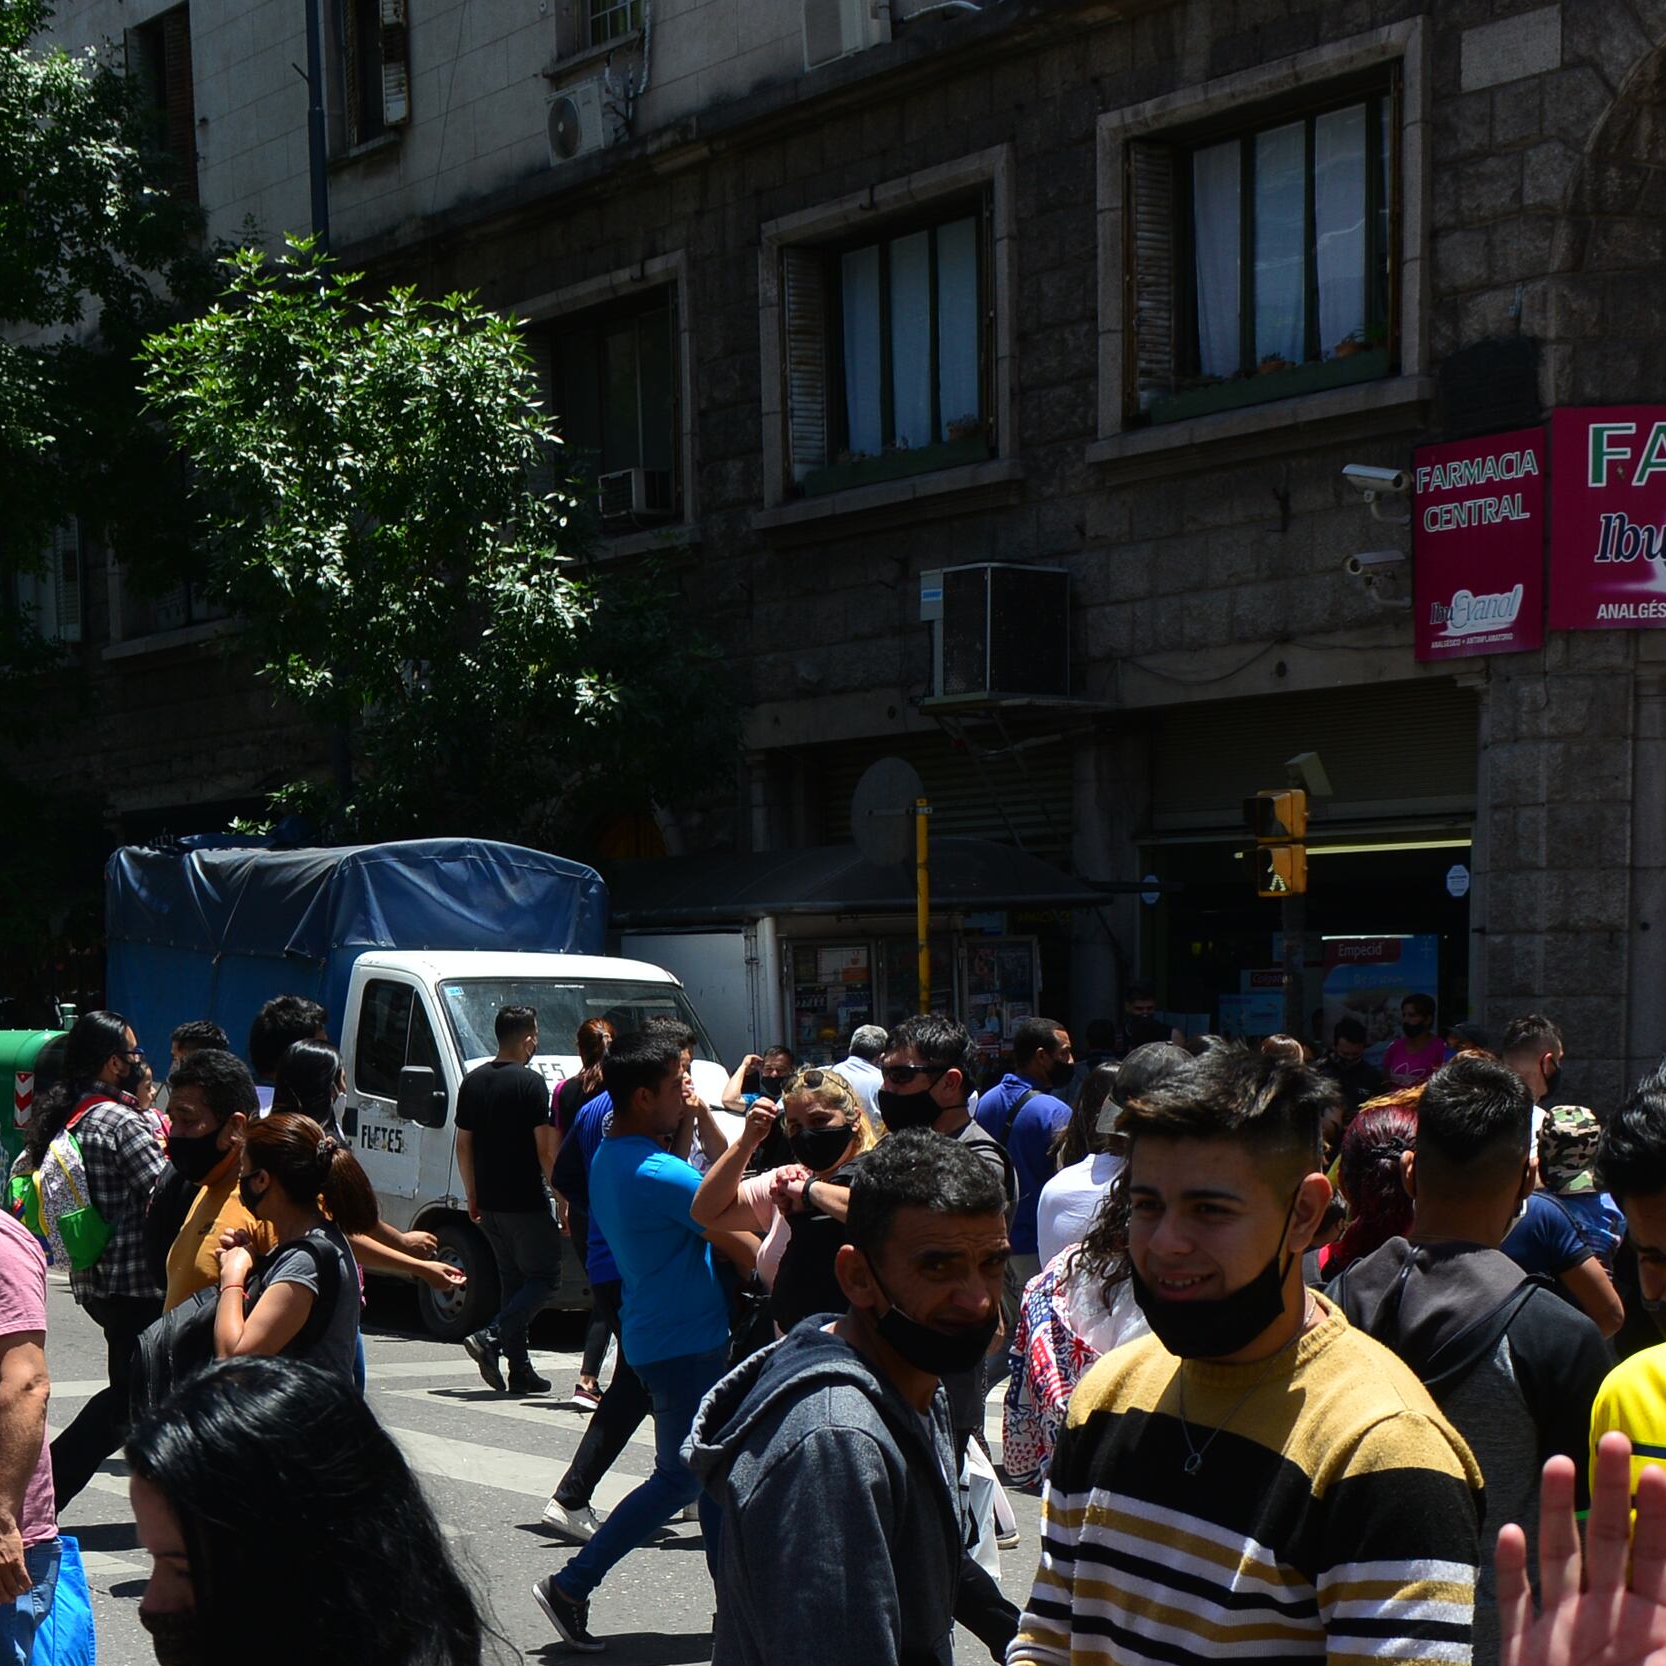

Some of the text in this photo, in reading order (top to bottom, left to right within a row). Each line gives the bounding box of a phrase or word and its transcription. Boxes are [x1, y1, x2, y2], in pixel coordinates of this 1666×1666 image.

[1416, 449, 1539, 494] FARMACIA
[1423, 493, 1531, 533] CENTRAL
[1338, 942, 1382, 959] Empecid
[362, 1124, 403, 1153] FLETES
